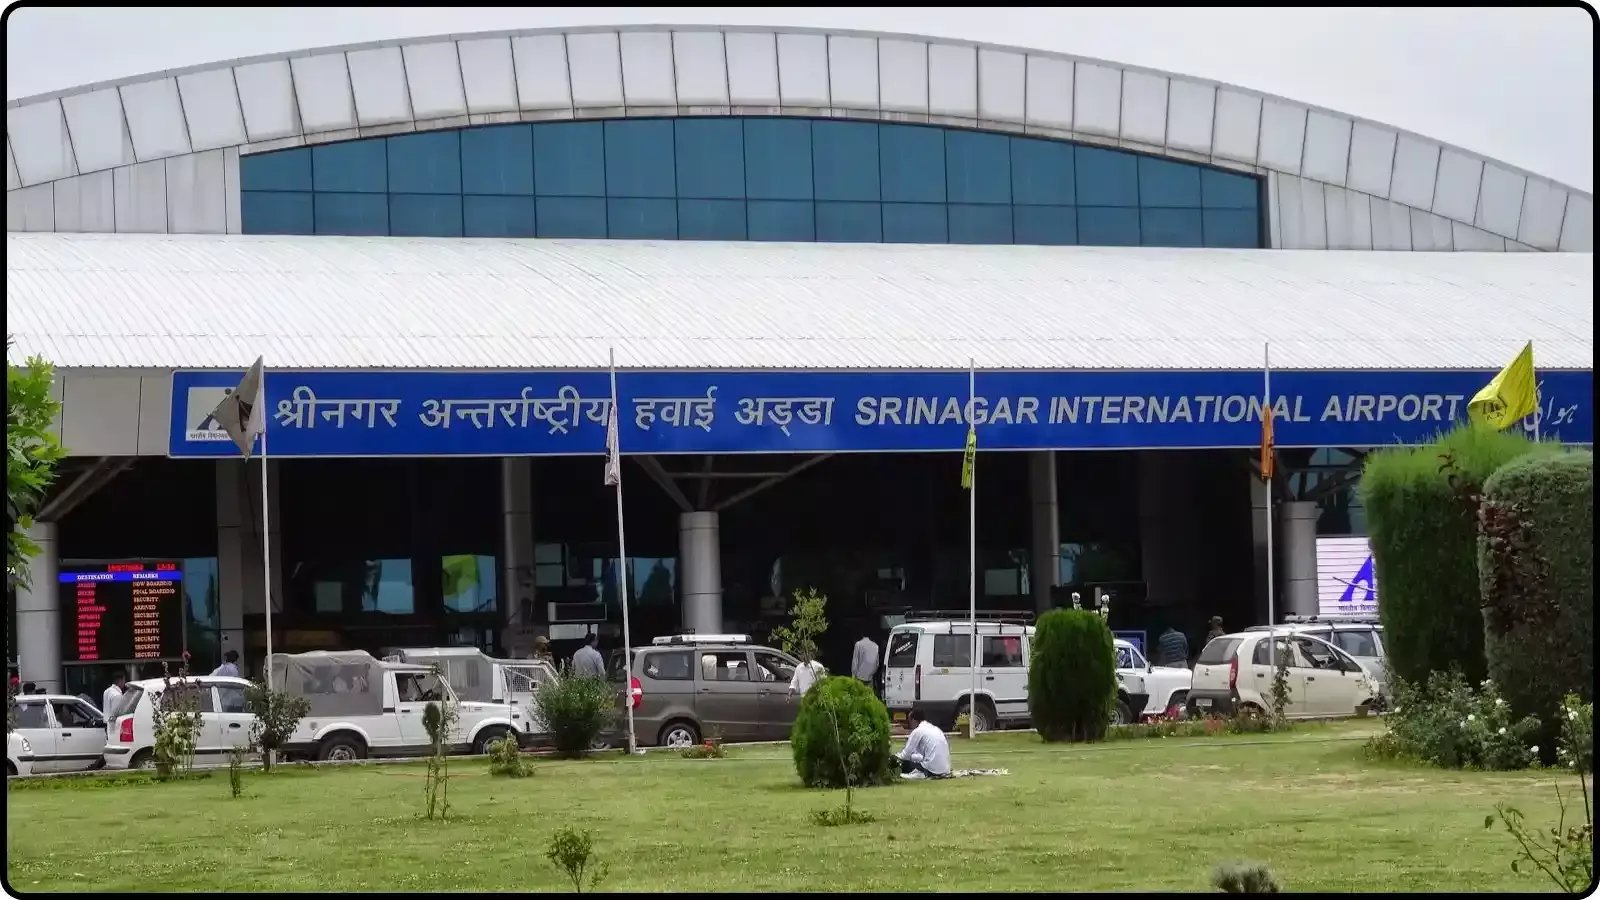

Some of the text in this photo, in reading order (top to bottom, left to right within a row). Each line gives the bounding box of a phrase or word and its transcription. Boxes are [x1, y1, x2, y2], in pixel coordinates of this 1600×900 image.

[273, 386, 401, 428] श्रीनगर
[632, 386, 718, 431] हवाई
[734, 397, 835, 437] अड्डा
[855, 396, 1039, 425] SRINAGAR
[1048, 395, 1311, 423] INTERNATIONAL
[1320, 394, 1464, 421] AIRPORT
